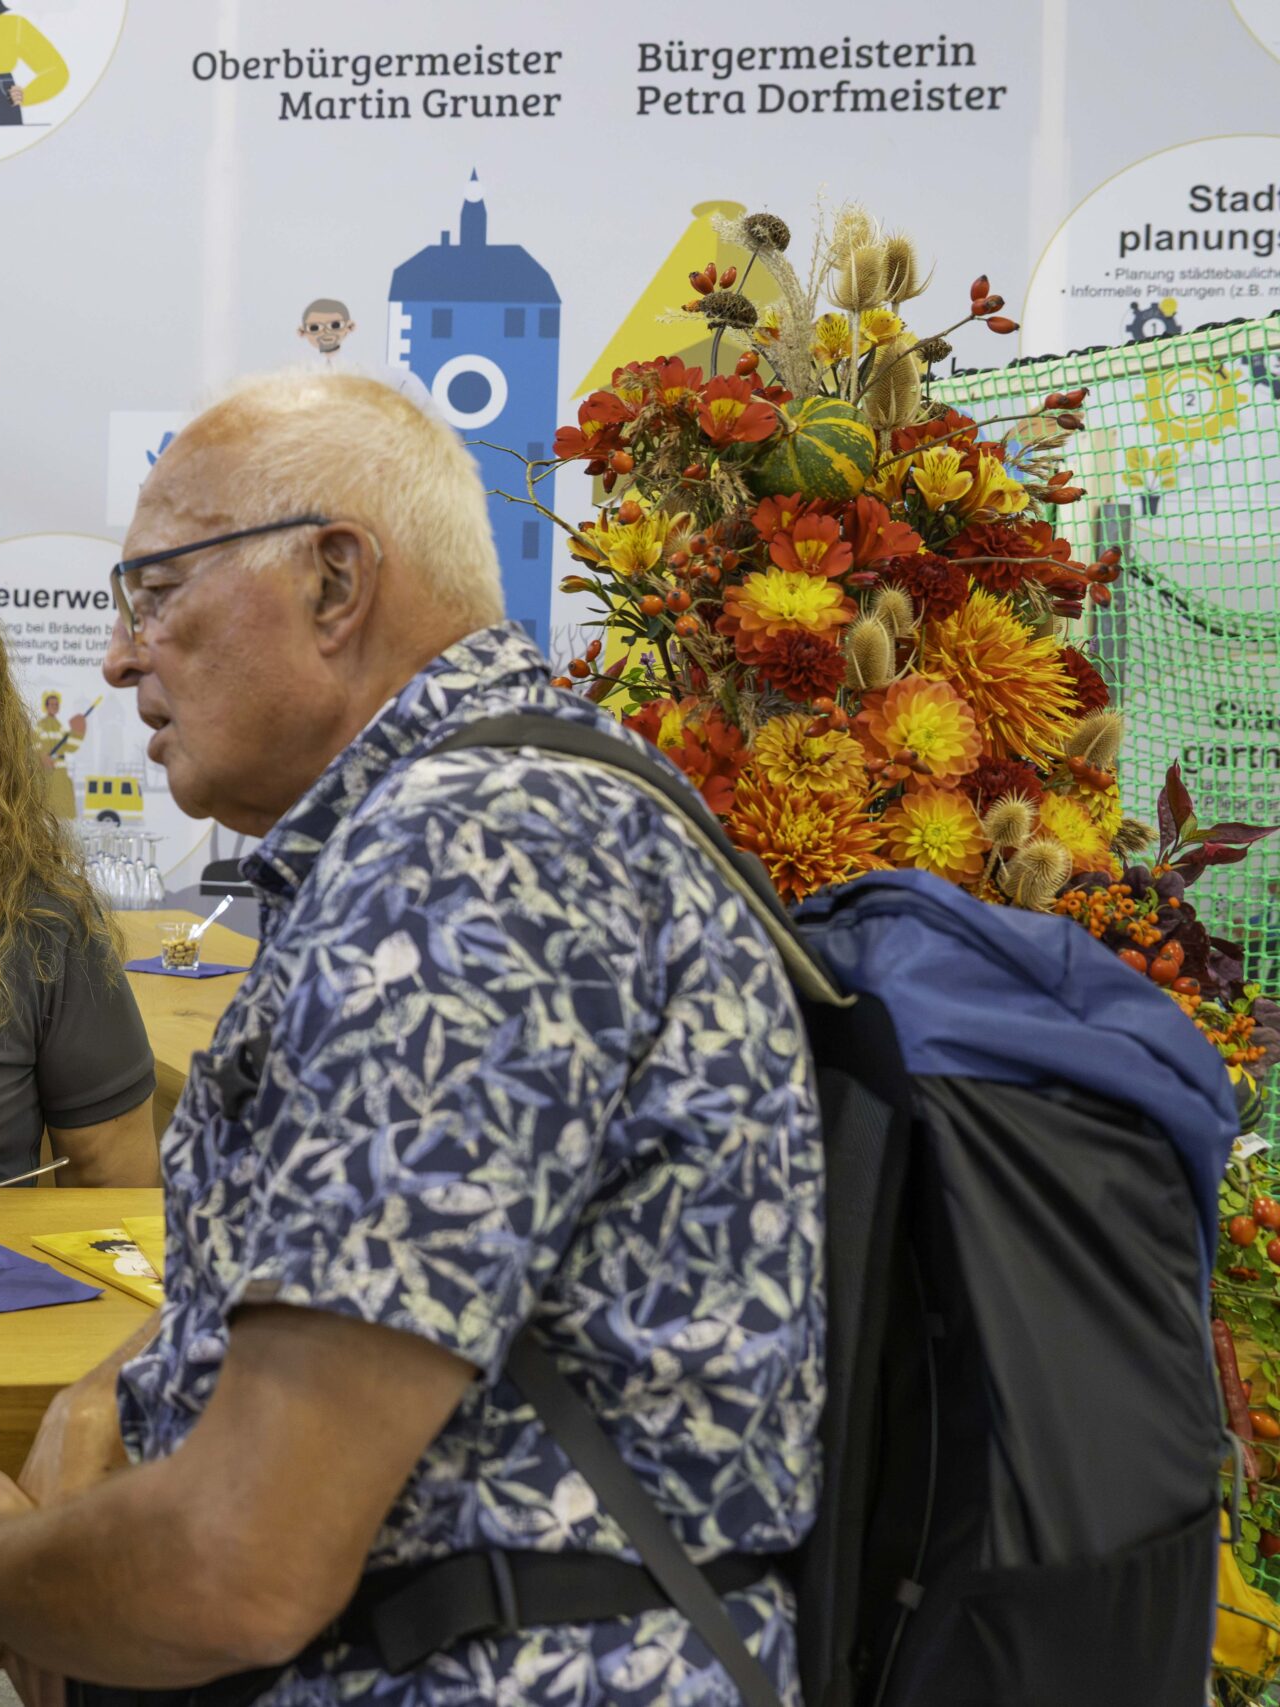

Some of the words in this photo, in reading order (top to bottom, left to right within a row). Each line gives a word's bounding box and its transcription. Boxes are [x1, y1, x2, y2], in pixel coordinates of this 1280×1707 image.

[192, 44, 562, 86] Oberbürgermeister
[638, 34, 977, 80] Bürgermeisterin
[278, 89, 412, 121] Martin
[423, 89, 562, 119] Gruner
[637, 85, 746, 115] Petra
[757, 79, 1008, 114] Dorfmeister
[1189, 183, 1280, 213] Stad
[1120, 223, 1280, 258] planung
[1114, 267, 1175, 282] Planung
[1071, 285, 1142, 298] Informelle
[1146, 284, 1226, 299] Planungen
[1268, 287, 1280, 297] m
[1186, 393, 1196, 407] 2
[25, 622, 45, 635] bei
[49, 622, 102, 636] Bränden
[63, 639, 81, 651] bei
